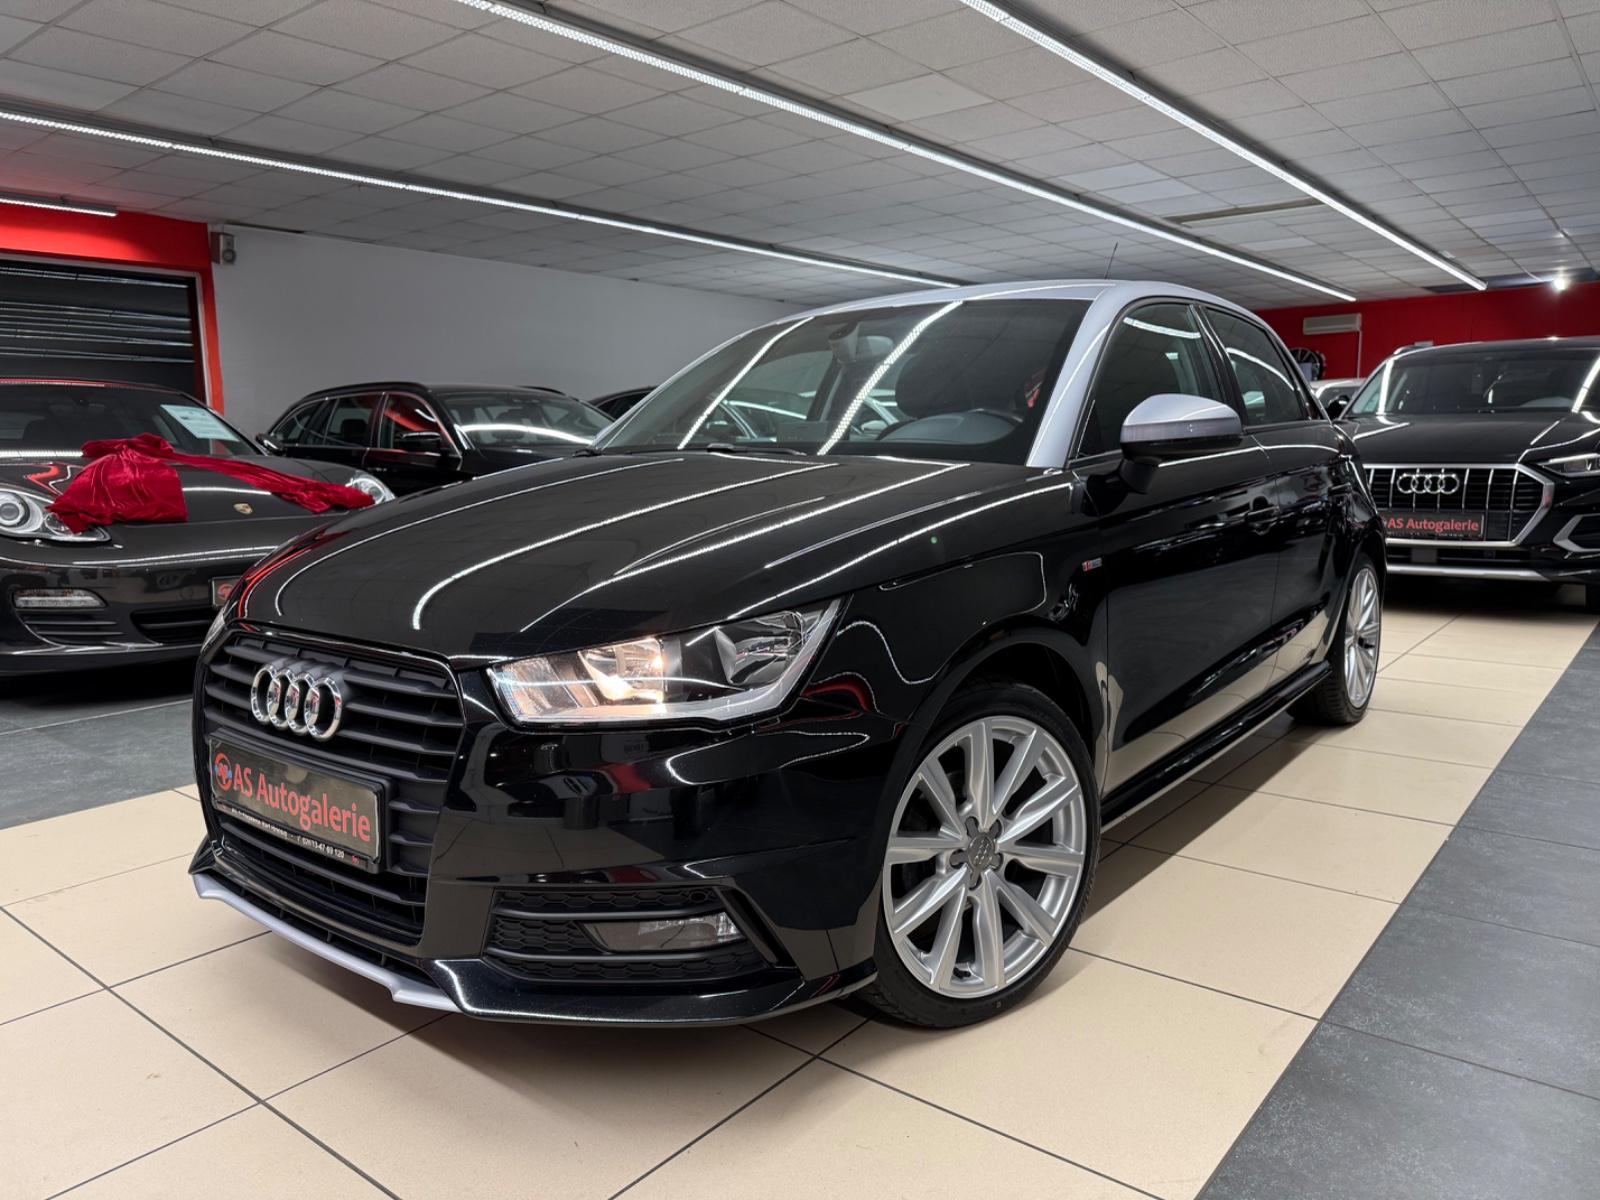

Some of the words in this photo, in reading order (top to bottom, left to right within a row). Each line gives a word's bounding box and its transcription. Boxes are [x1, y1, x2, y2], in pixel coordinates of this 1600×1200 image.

[1387, 517, 1404, 529] AS
[1406, 517, 1479, 533] Autogalerie
[233, 763, 253, 798] AS
[256, 772, 371, 843] Autogalerie
